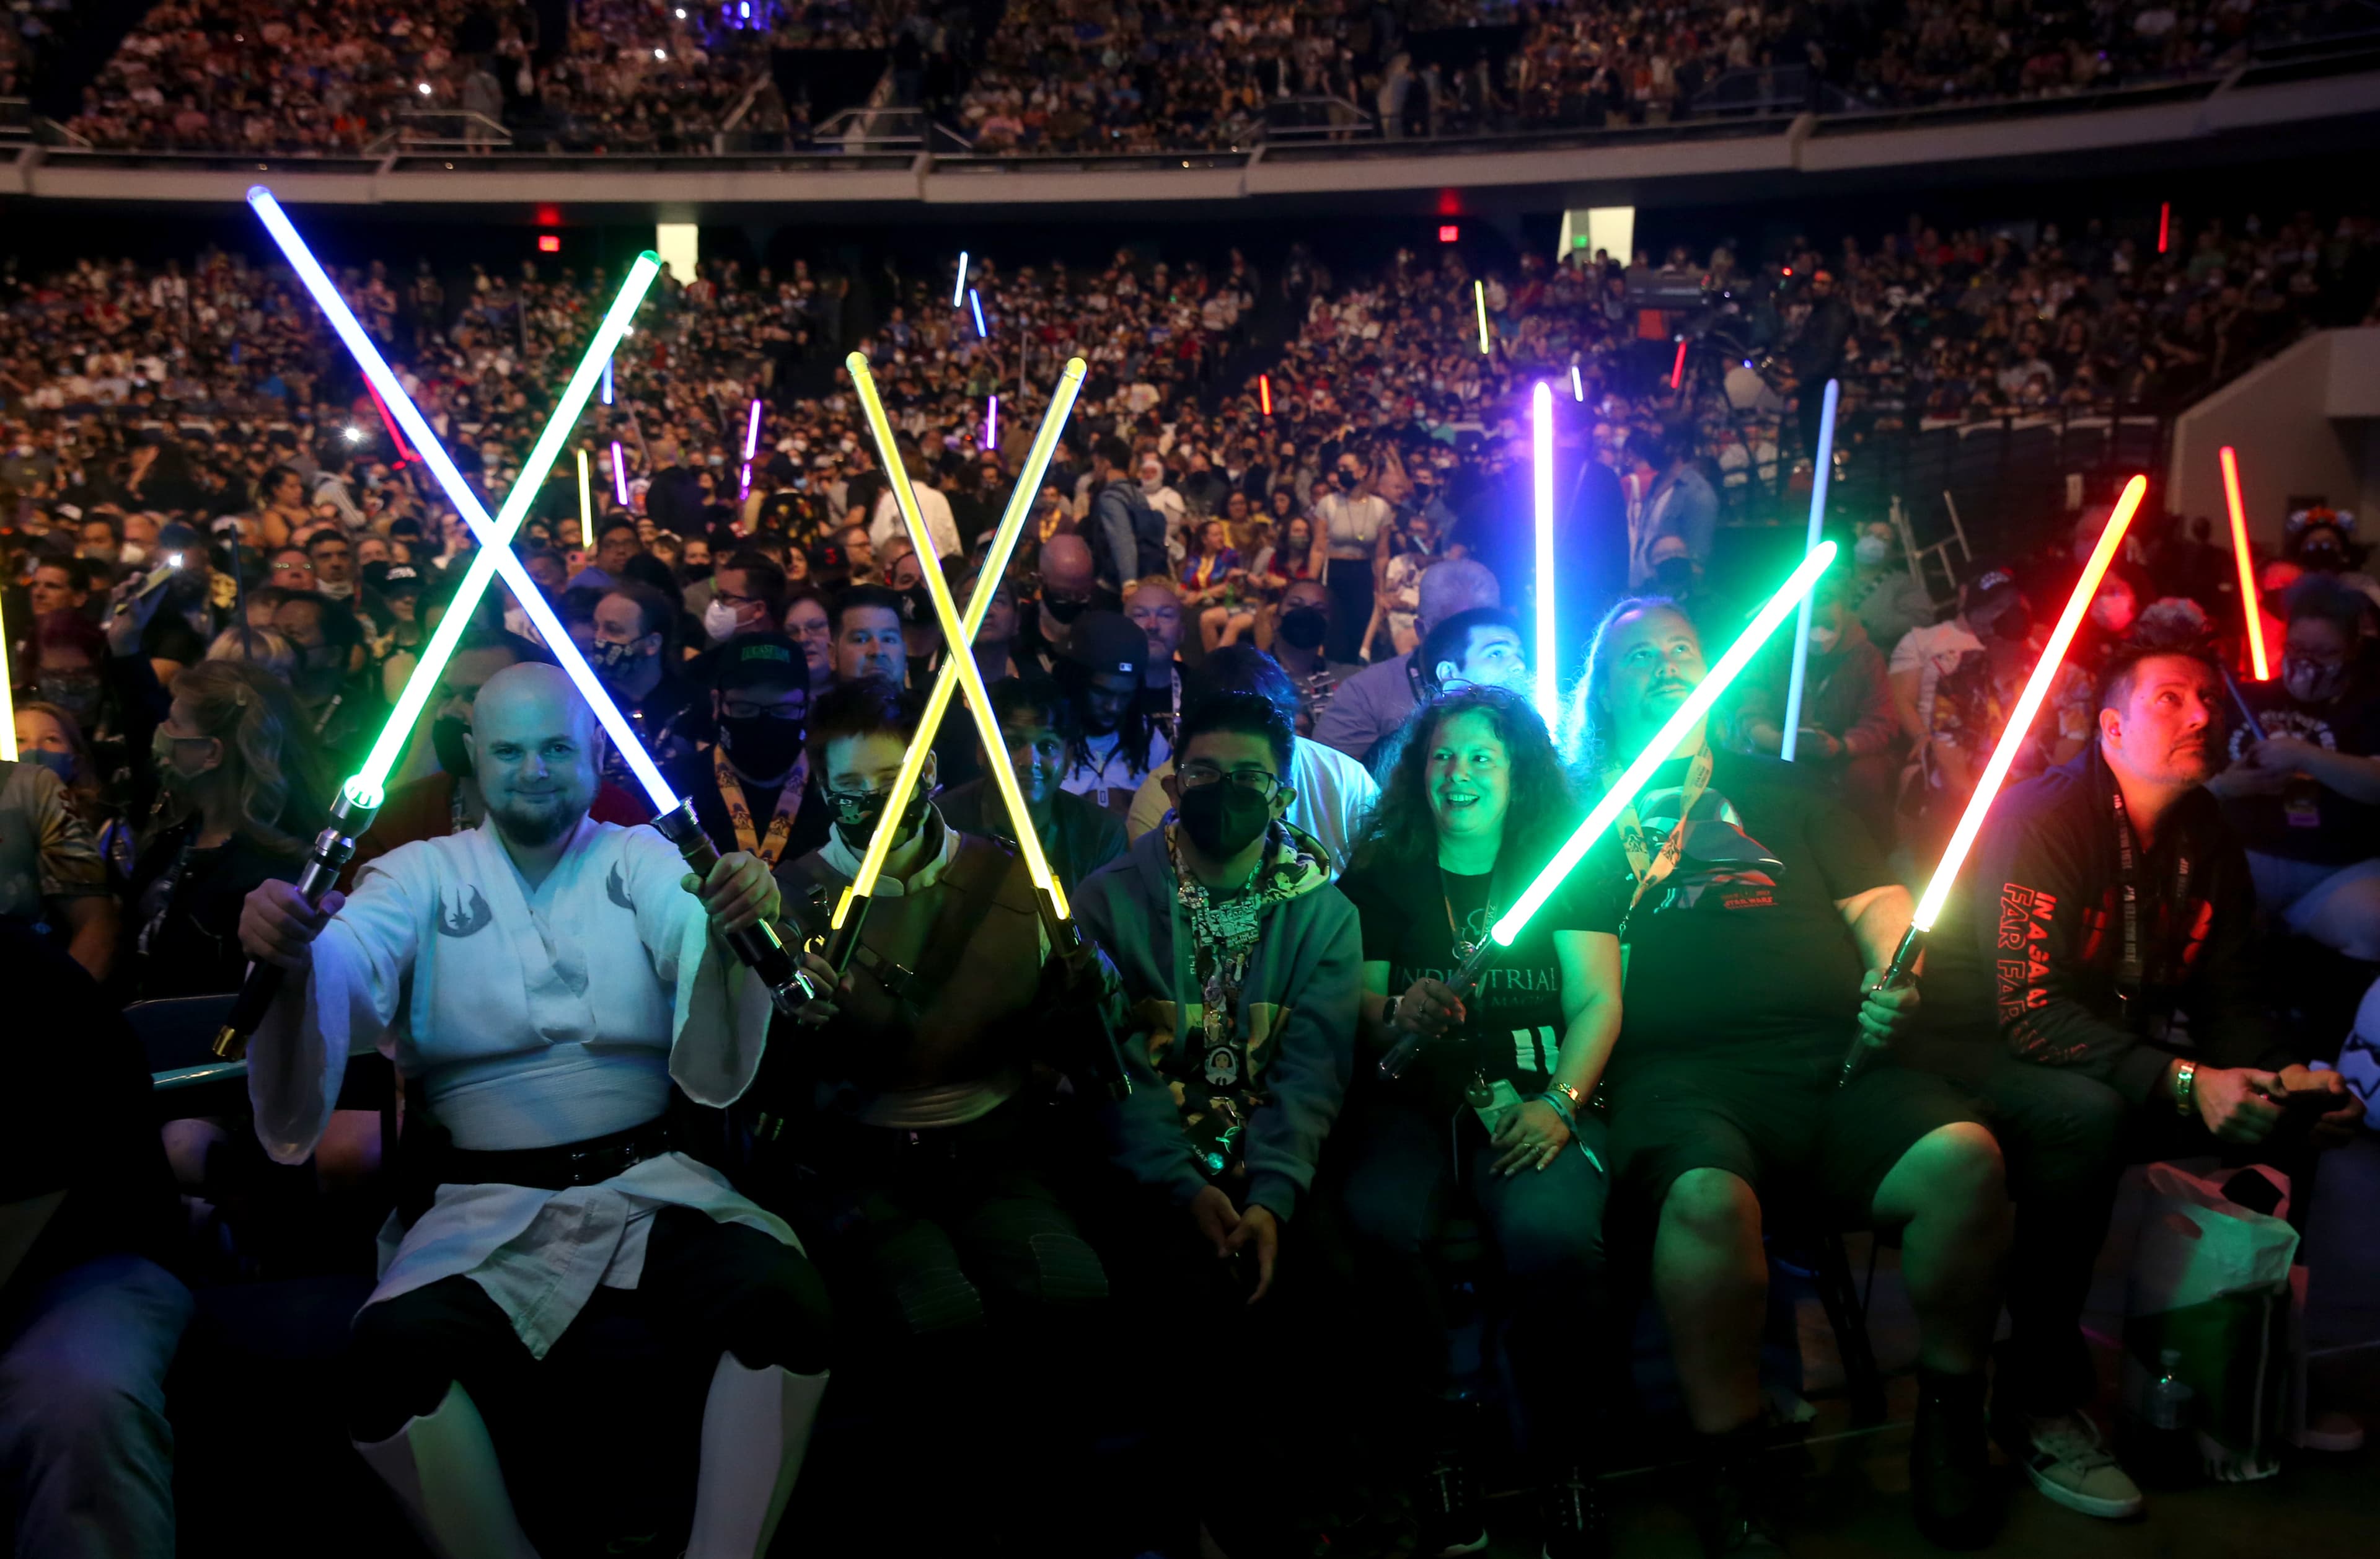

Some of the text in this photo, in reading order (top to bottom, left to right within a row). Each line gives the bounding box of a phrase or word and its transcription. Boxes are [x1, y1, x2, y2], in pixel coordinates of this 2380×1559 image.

[1998, 883, 2035, 950] FAR
[2032, 891, 2058, 921] IN
[2027, 922, 2049, 940] A
[1396, 965, 1558, 991] INDTRIAL
